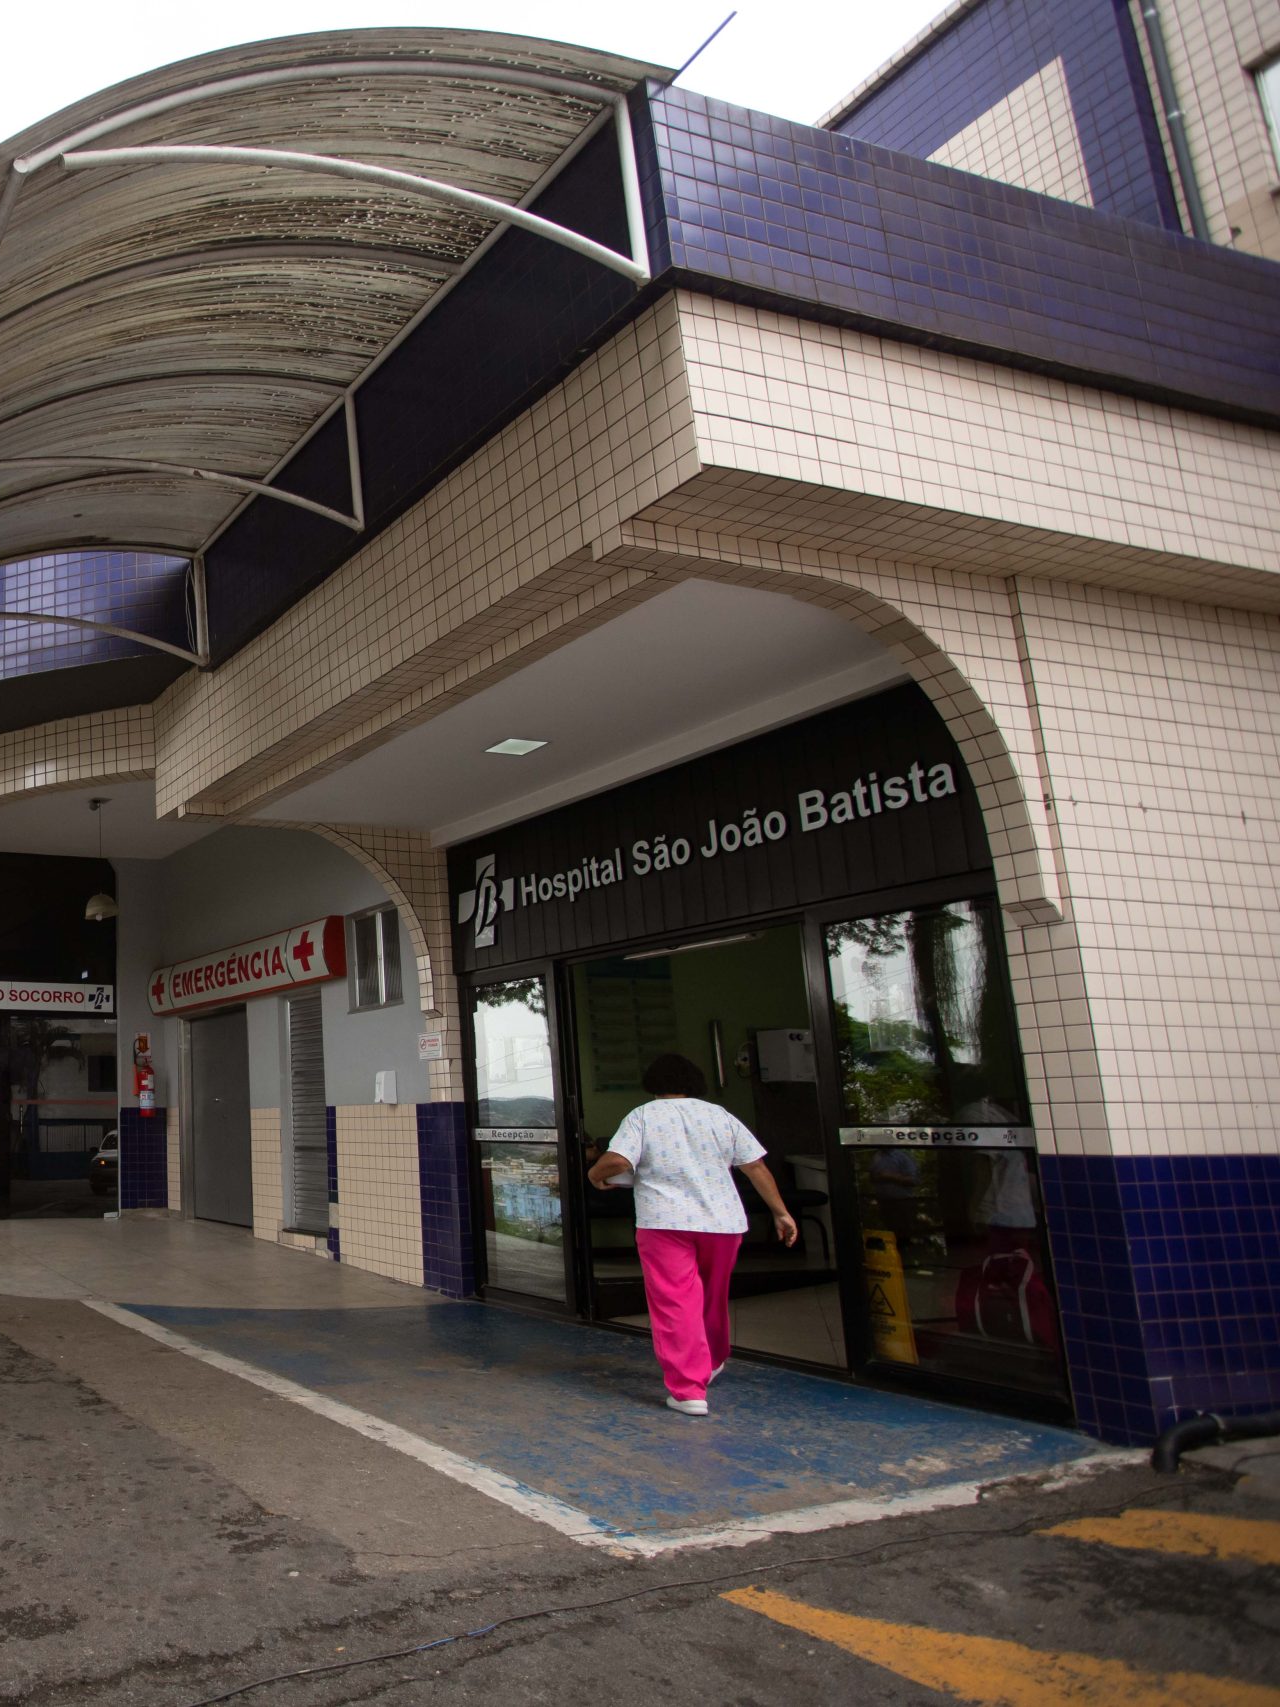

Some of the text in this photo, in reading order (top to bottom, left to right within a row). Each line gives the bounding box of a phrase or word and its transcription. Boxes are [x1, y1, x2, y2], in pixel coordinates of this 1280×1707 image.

[520, 847, 623, 903] Hospital
[631, 834, 690, 876] São
[700, 807, 787, 858] João
[798, 761, 957, 832] Batista
[172, 946, 286, 998] EMERGÊNCIA
[8, 989, 85, 1004] SOCORRO
[491, 1129, 535, 1140] Recepção
